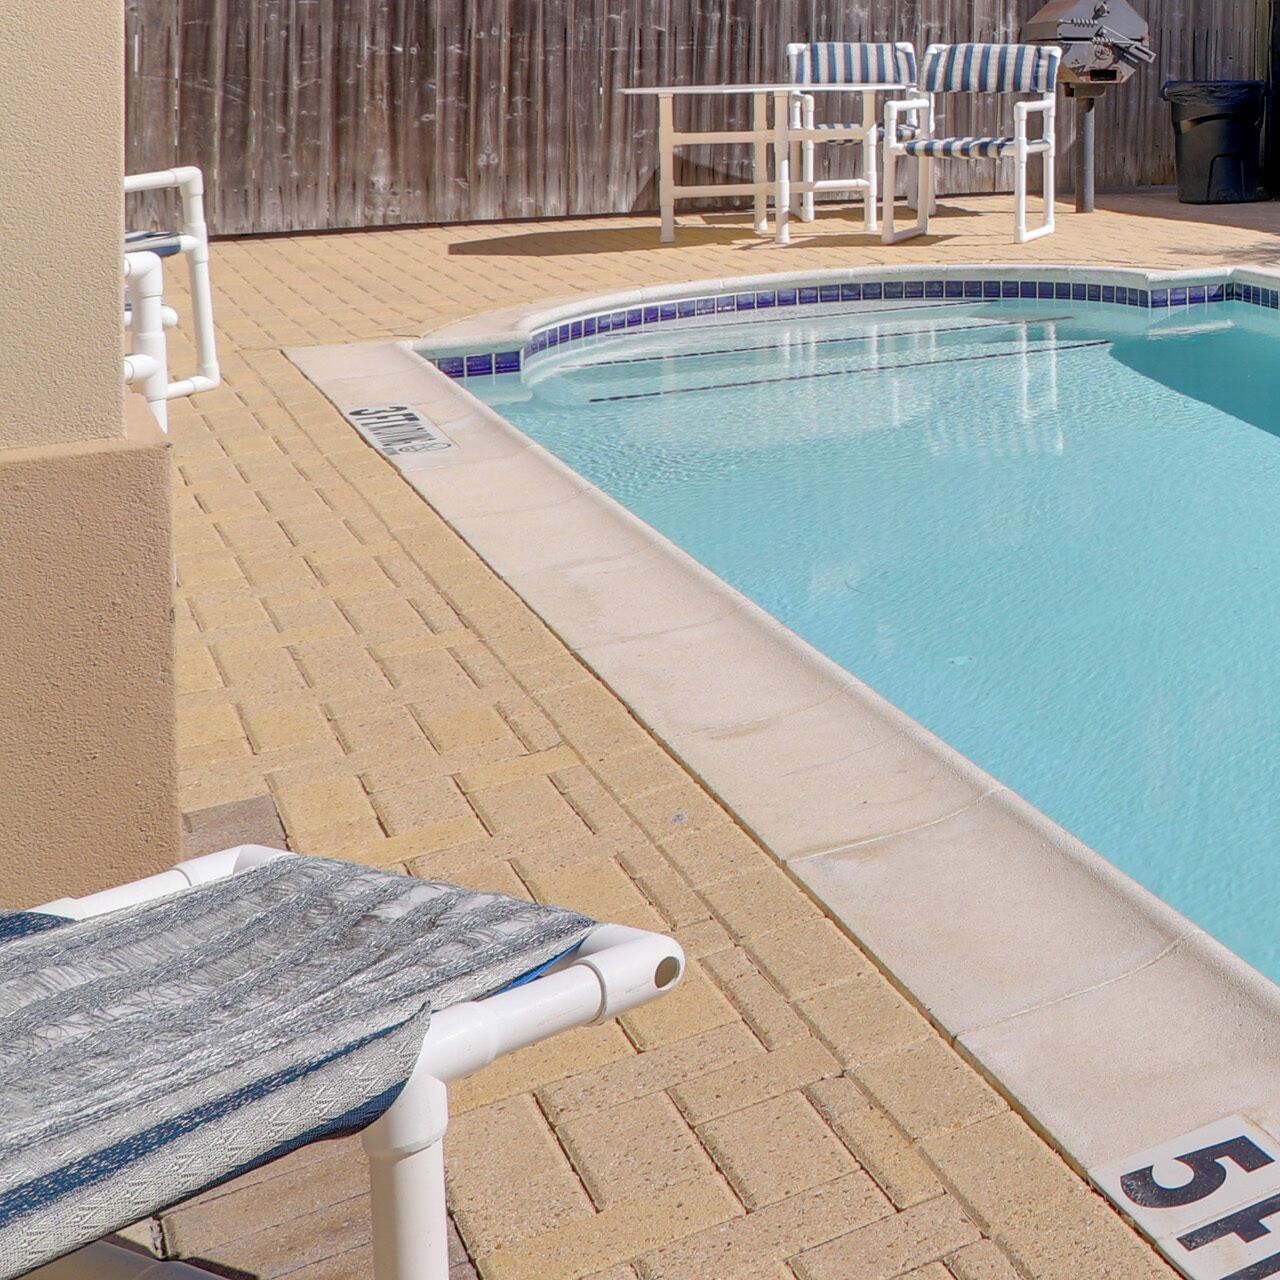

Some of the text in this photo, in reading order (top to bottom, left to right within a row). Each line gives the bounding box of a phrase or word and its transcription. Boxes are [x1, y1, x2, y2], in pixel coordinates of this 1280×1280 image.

[349, 406, 420, 427] 3 FT
[1120, 1135, 1275, 1209] 5
